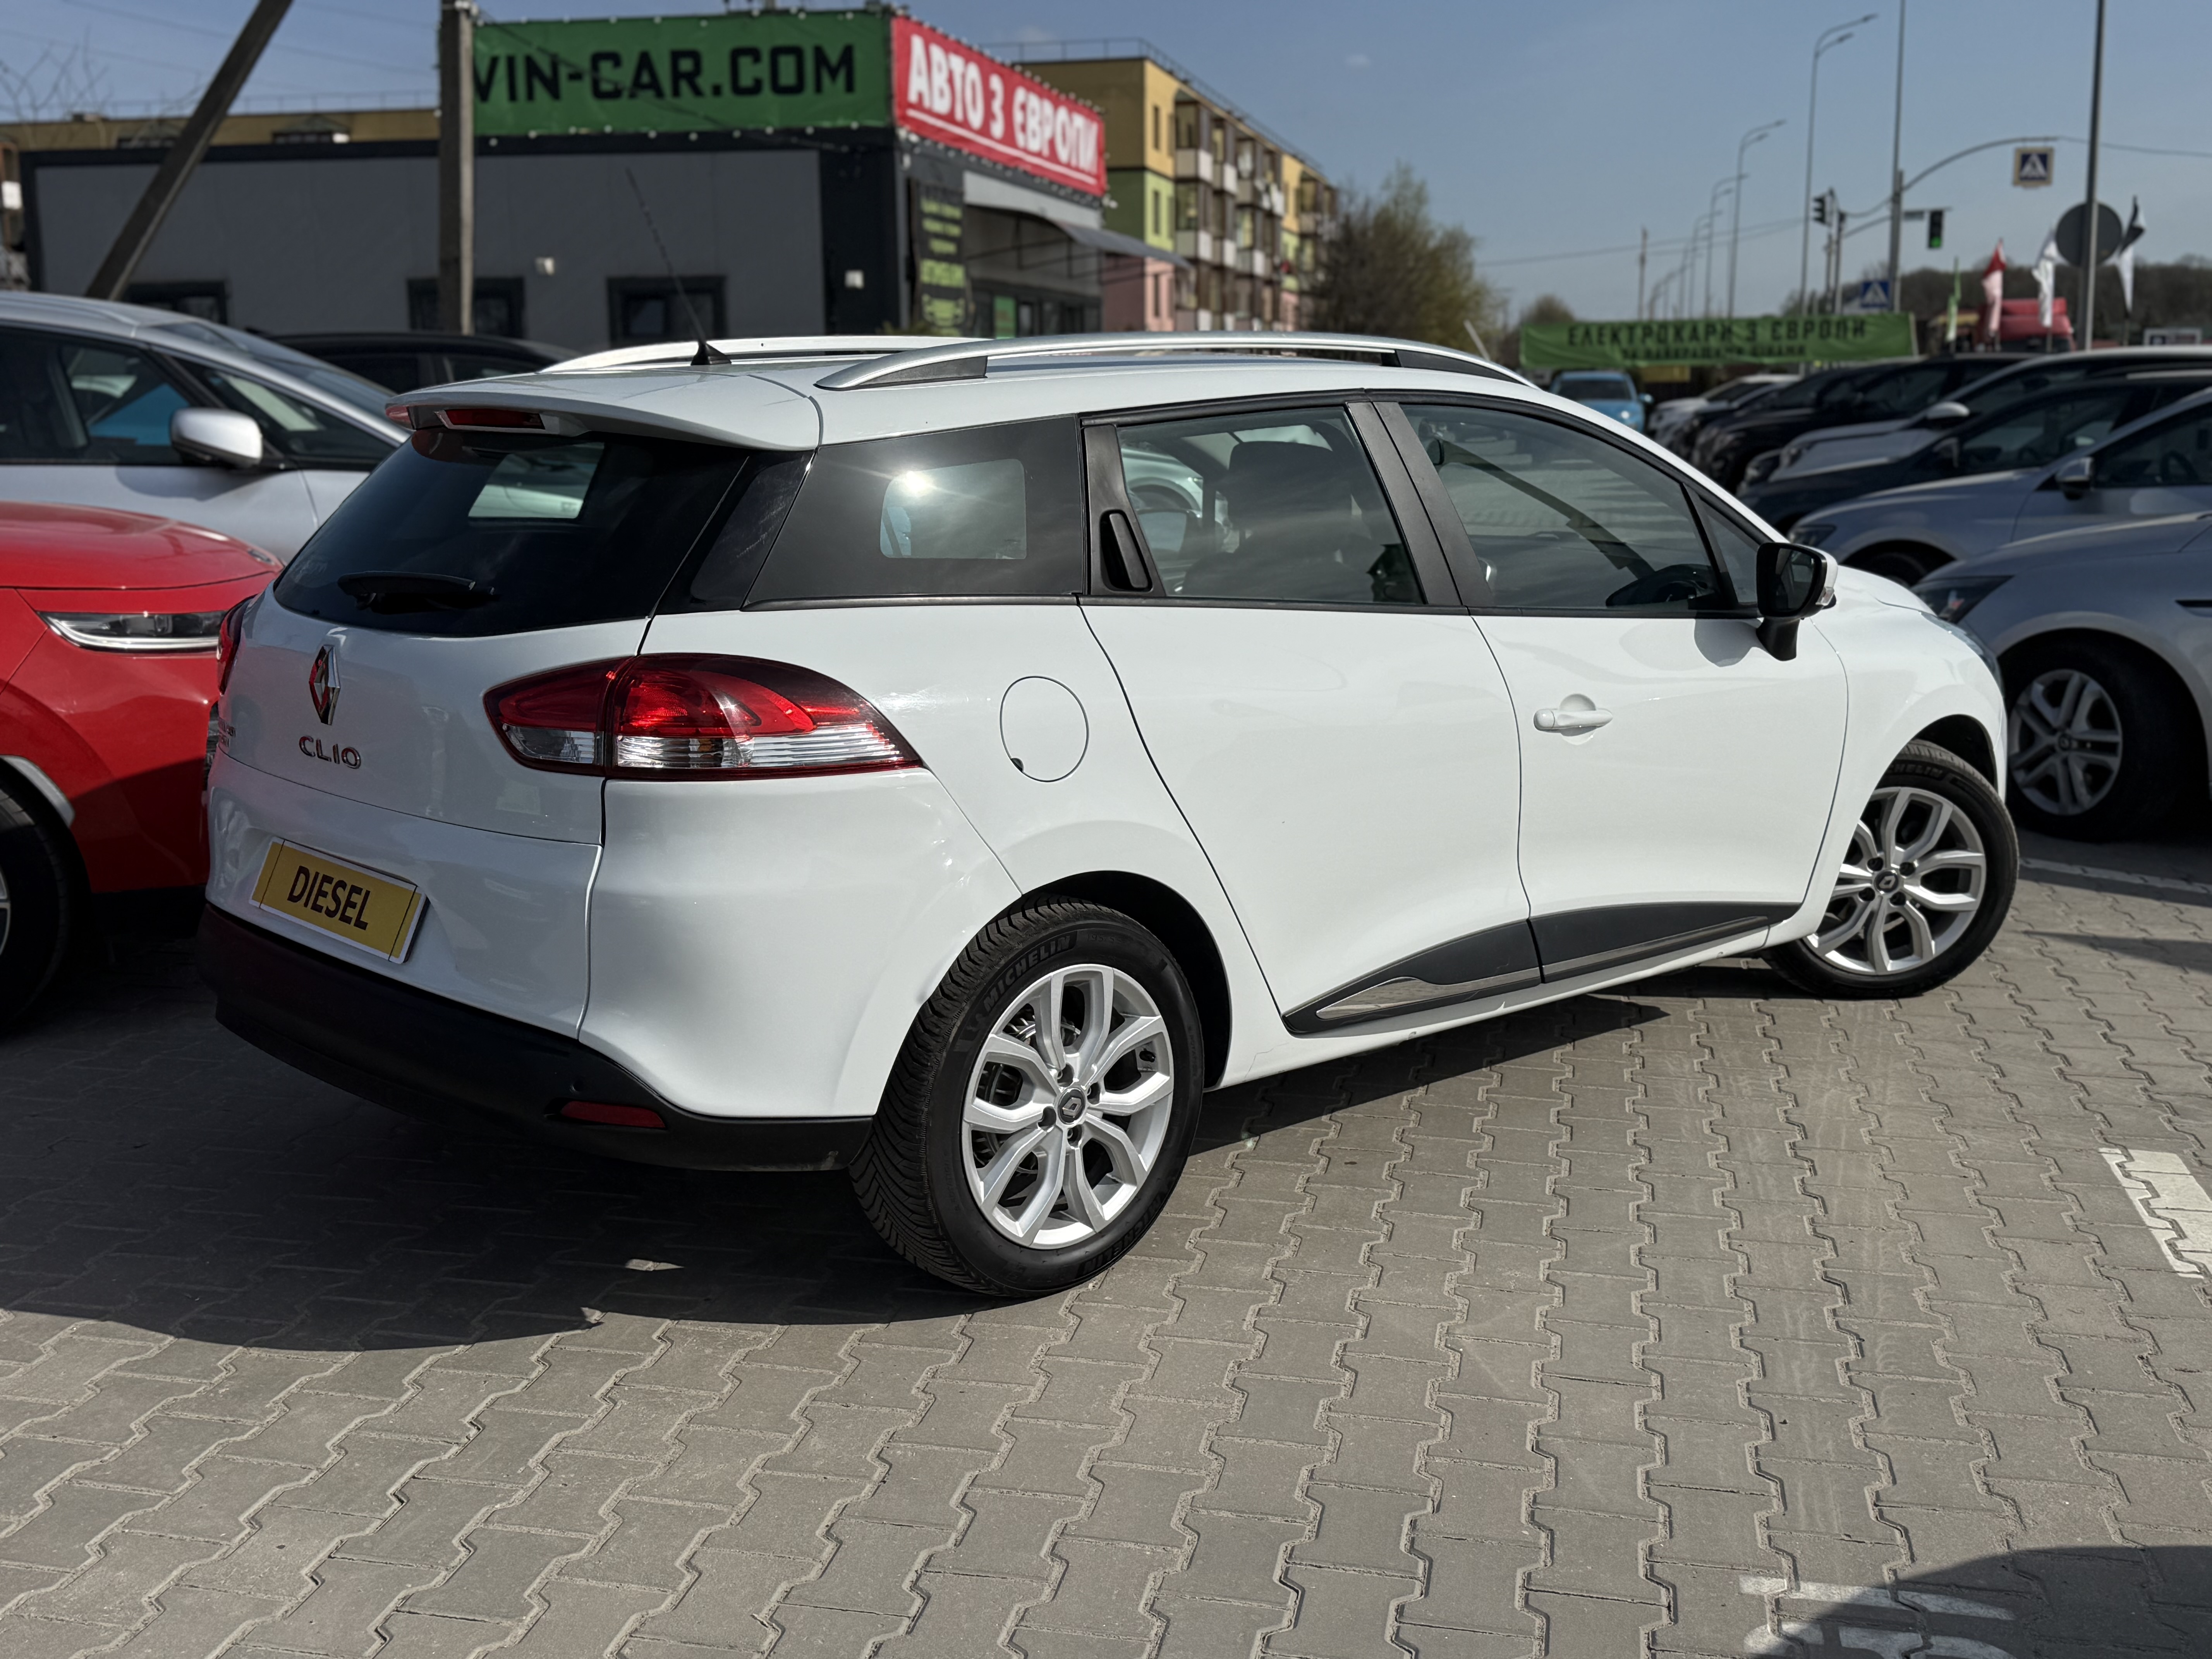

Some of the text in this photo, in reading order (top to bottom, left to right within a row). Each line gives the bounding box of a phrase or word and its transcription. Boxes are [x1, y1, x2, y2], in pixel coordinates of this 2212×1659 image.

[474, 45, 855, 102] VIN-CAR.COM
[907, 34, 1098, 174] АВТО З ЄВРОПИ
[1568, 318, 1865, 346] ЕЛЕКТРОКАРИ З ЄВРОПИ
[299, 735, 361, 769] CLIO
[1887, 763, 1943, 778] CHELIN
[287, 866, 371, 930] DIESEL
[983, 935, 1071, 1013] MICHELIN
